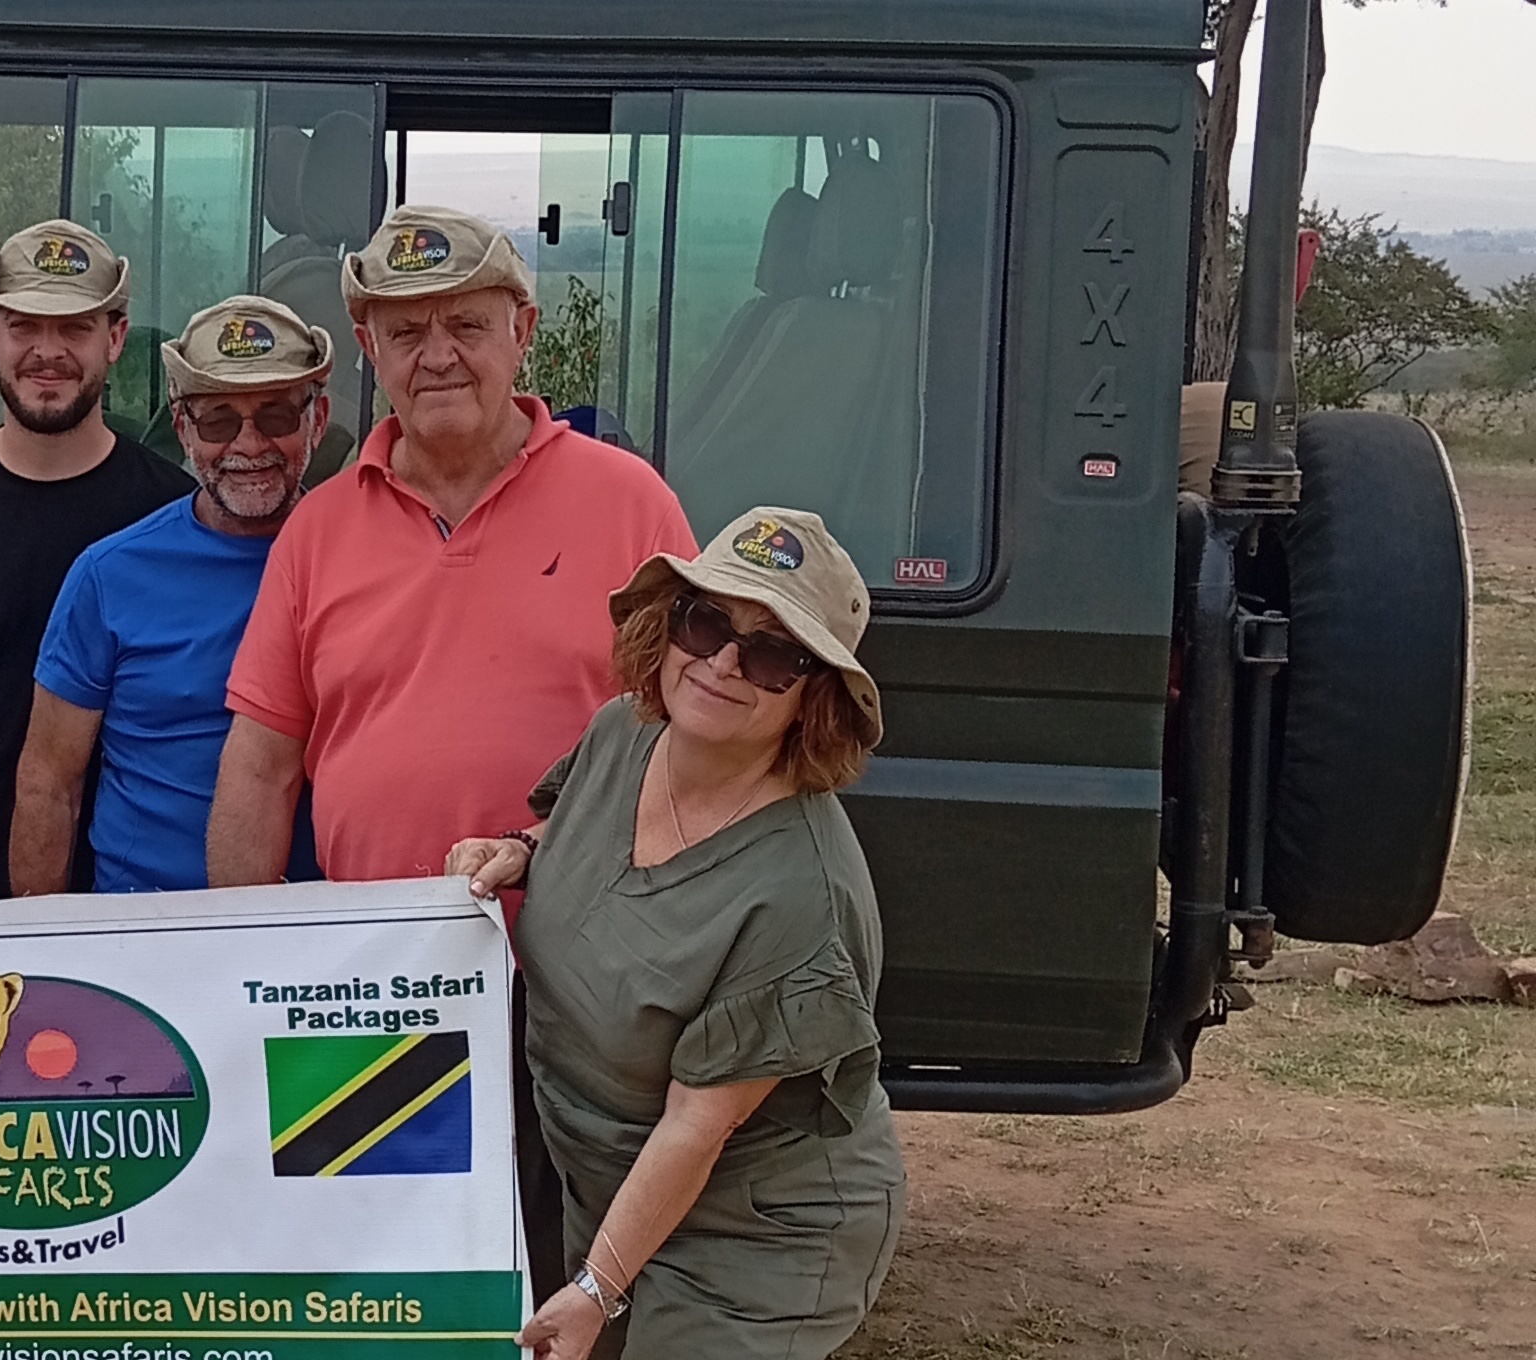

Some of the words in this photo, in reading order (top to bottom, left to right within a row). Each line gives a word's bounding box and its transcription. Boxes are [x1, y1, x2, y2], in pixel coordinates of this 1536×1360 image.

[899, 562, 942, 578] HAL
[243, 977, 380, 1004] Tanzania
[390, 970, 485, 1000] Safari
[287, 1005, 440, 1033] Packages
[70, 1292, 173, 1323] Africa
[182, 1291, 294, 1323] Vision
[304, 1291, 423, 1324] Safaris
